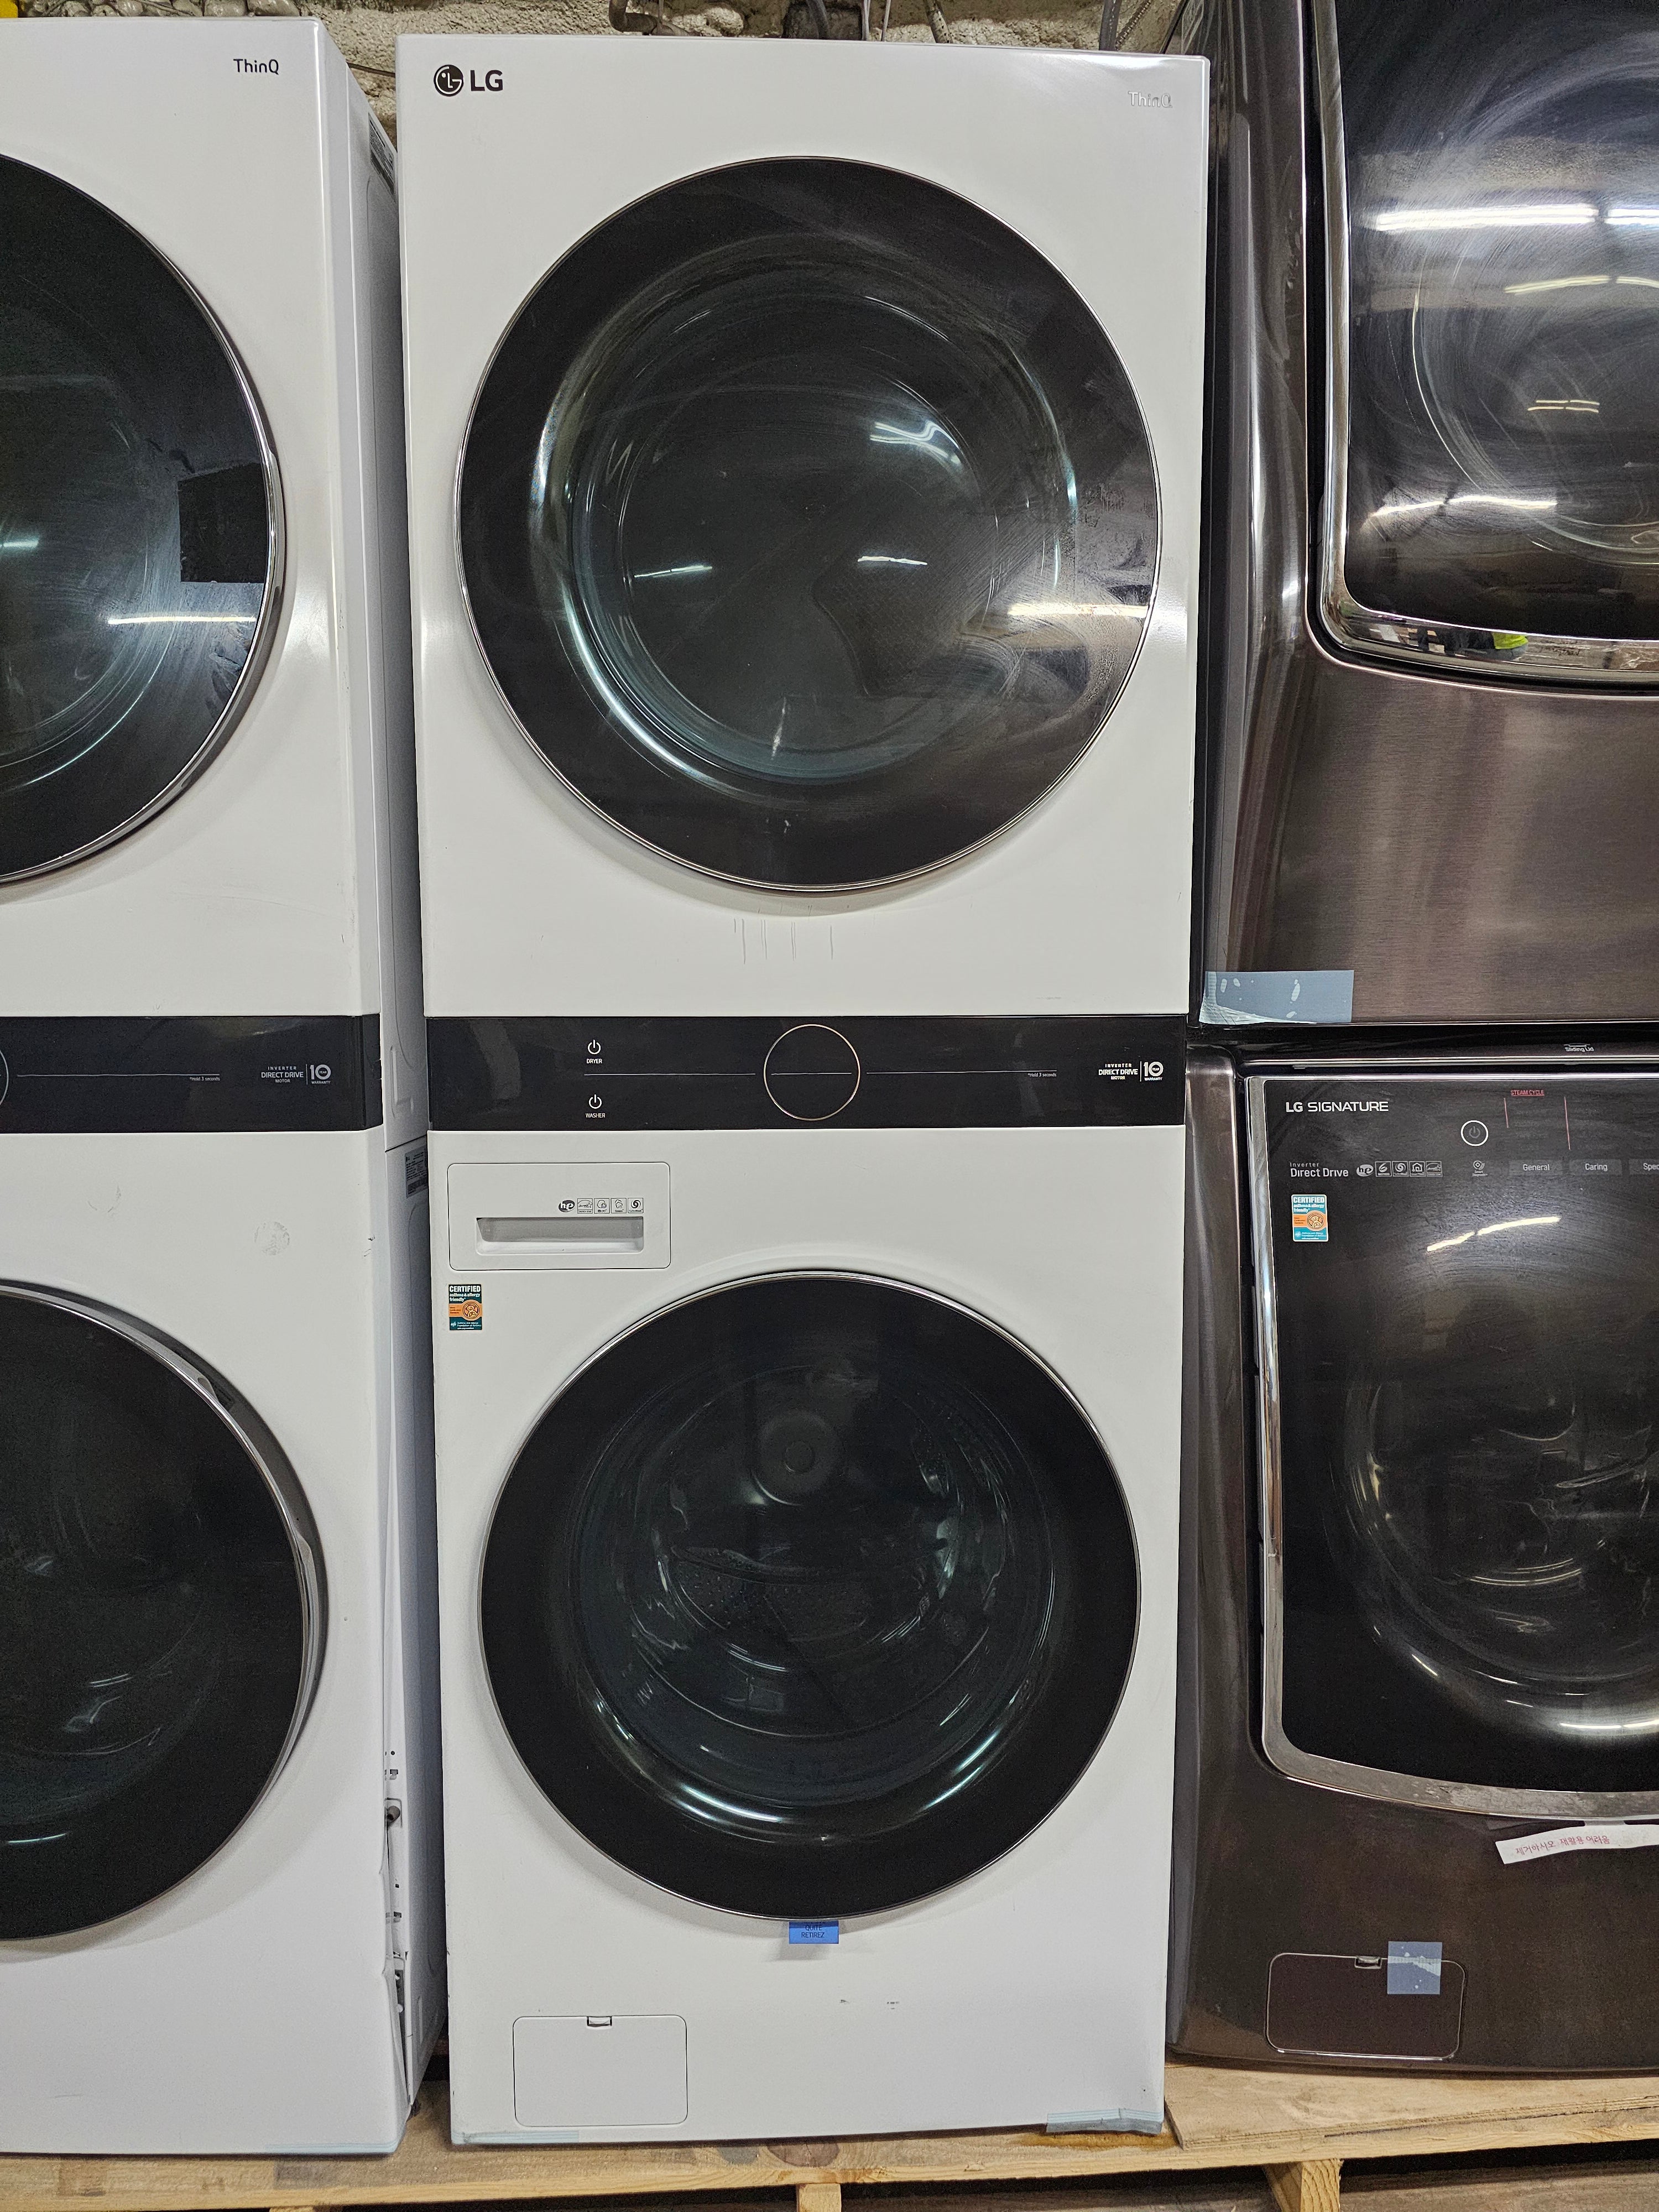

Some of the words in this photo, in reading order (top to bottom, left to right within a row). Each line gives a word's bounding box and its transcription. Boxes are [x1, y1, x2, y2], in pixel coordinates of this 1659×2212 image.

[233, 58, 279, 75] ThinQ
[470, 69, 503, 92] LG
[1128, 91, 1173, 108] ThinQ
[310, 1064, 331, 1080] 10
[1286, 1102, 1303, 1113] LG
[1307, 1101, 1389, 1112] SIGNATURE
[1290, 1168, 1321, 1178] Direct
[1323, 1168, 1349, 1178] Drive
[1585, 1163, 1608, 1172] Caring
[1559, 1836, 1584, 1846] 재활용
[1585, 1835, 1610, 1844] 어려움
